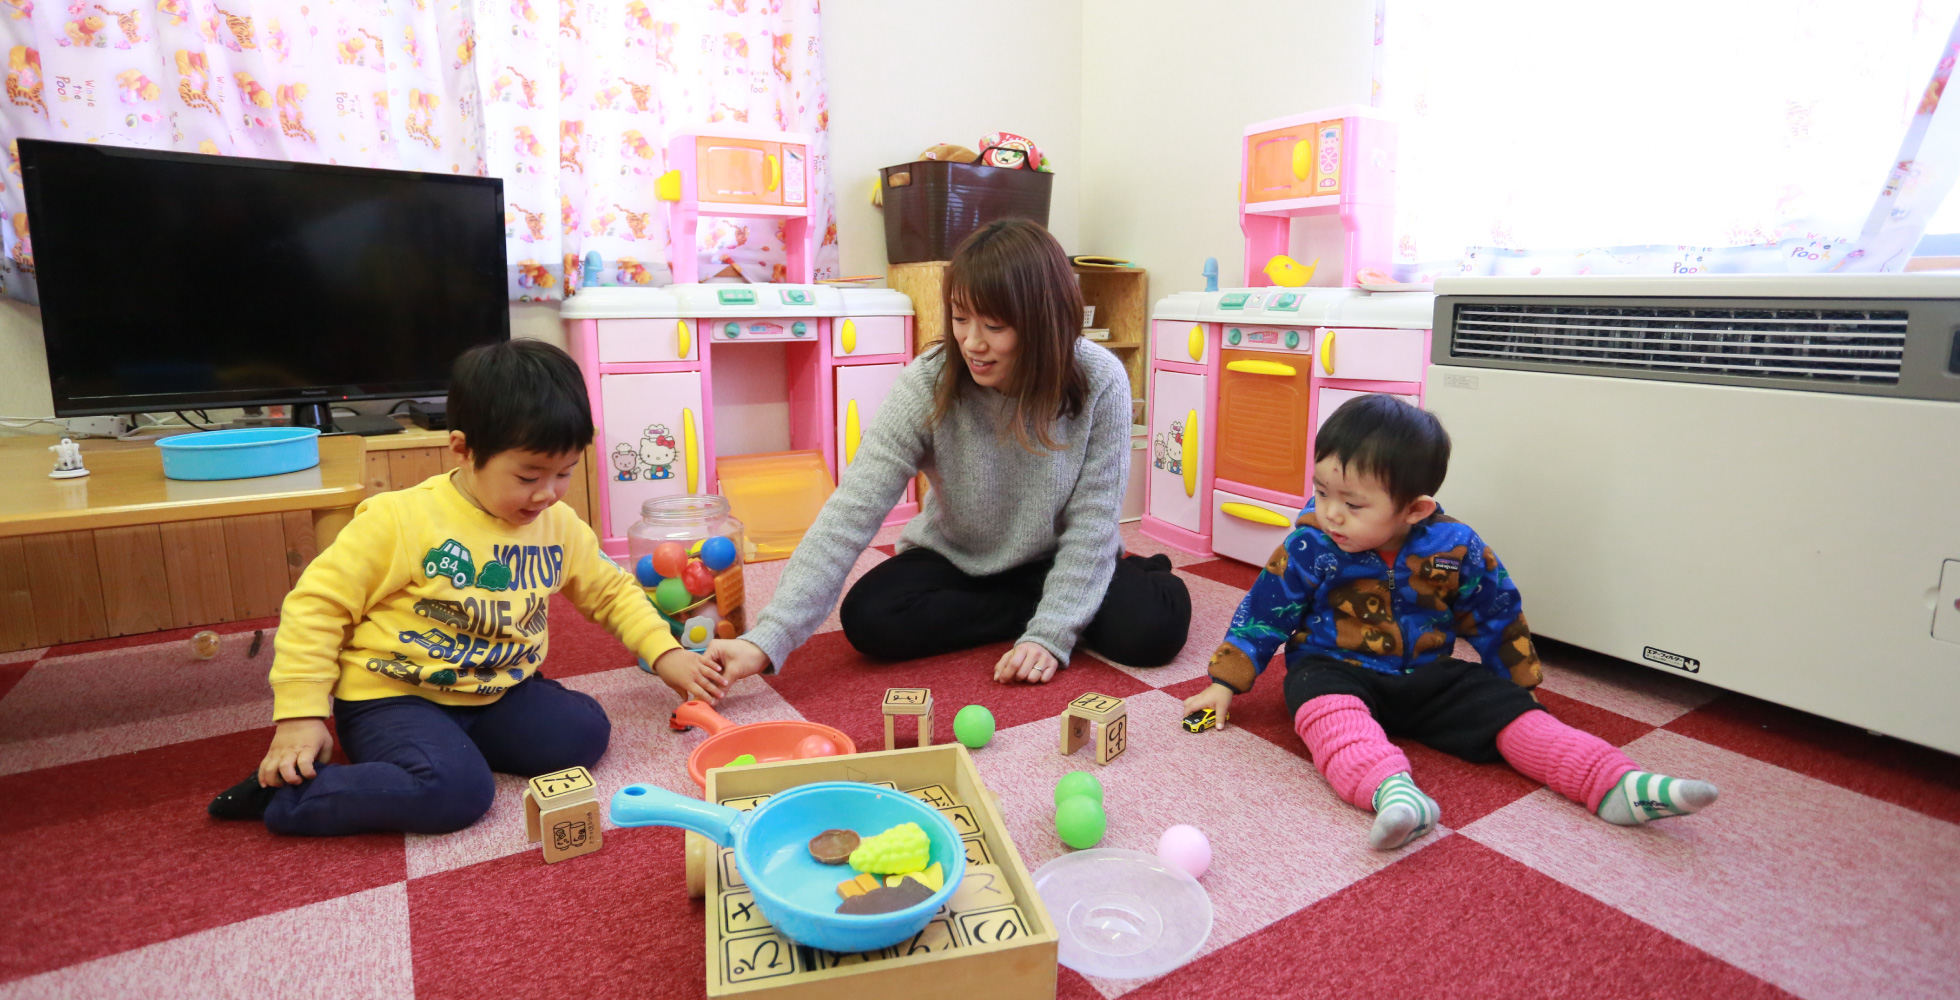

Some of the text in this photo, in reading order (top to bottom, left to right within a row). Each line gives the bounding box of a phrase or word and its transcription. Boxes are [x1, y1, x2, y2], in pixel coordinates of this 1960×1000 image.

[56, 75, 73, 103] Pooh
[73, 85, 82, 100] the
[84, 79, 95, 107] Winnie
[335, 91, 350, 117] Pooh
[1790, 247, 1831, 262] Pooh
[1672, 261, 1708, 274] Pooh
[439, 556, 458, 573] 84
[1108, 721, 1124, 754] お
[543, 773, 581, 793] た
